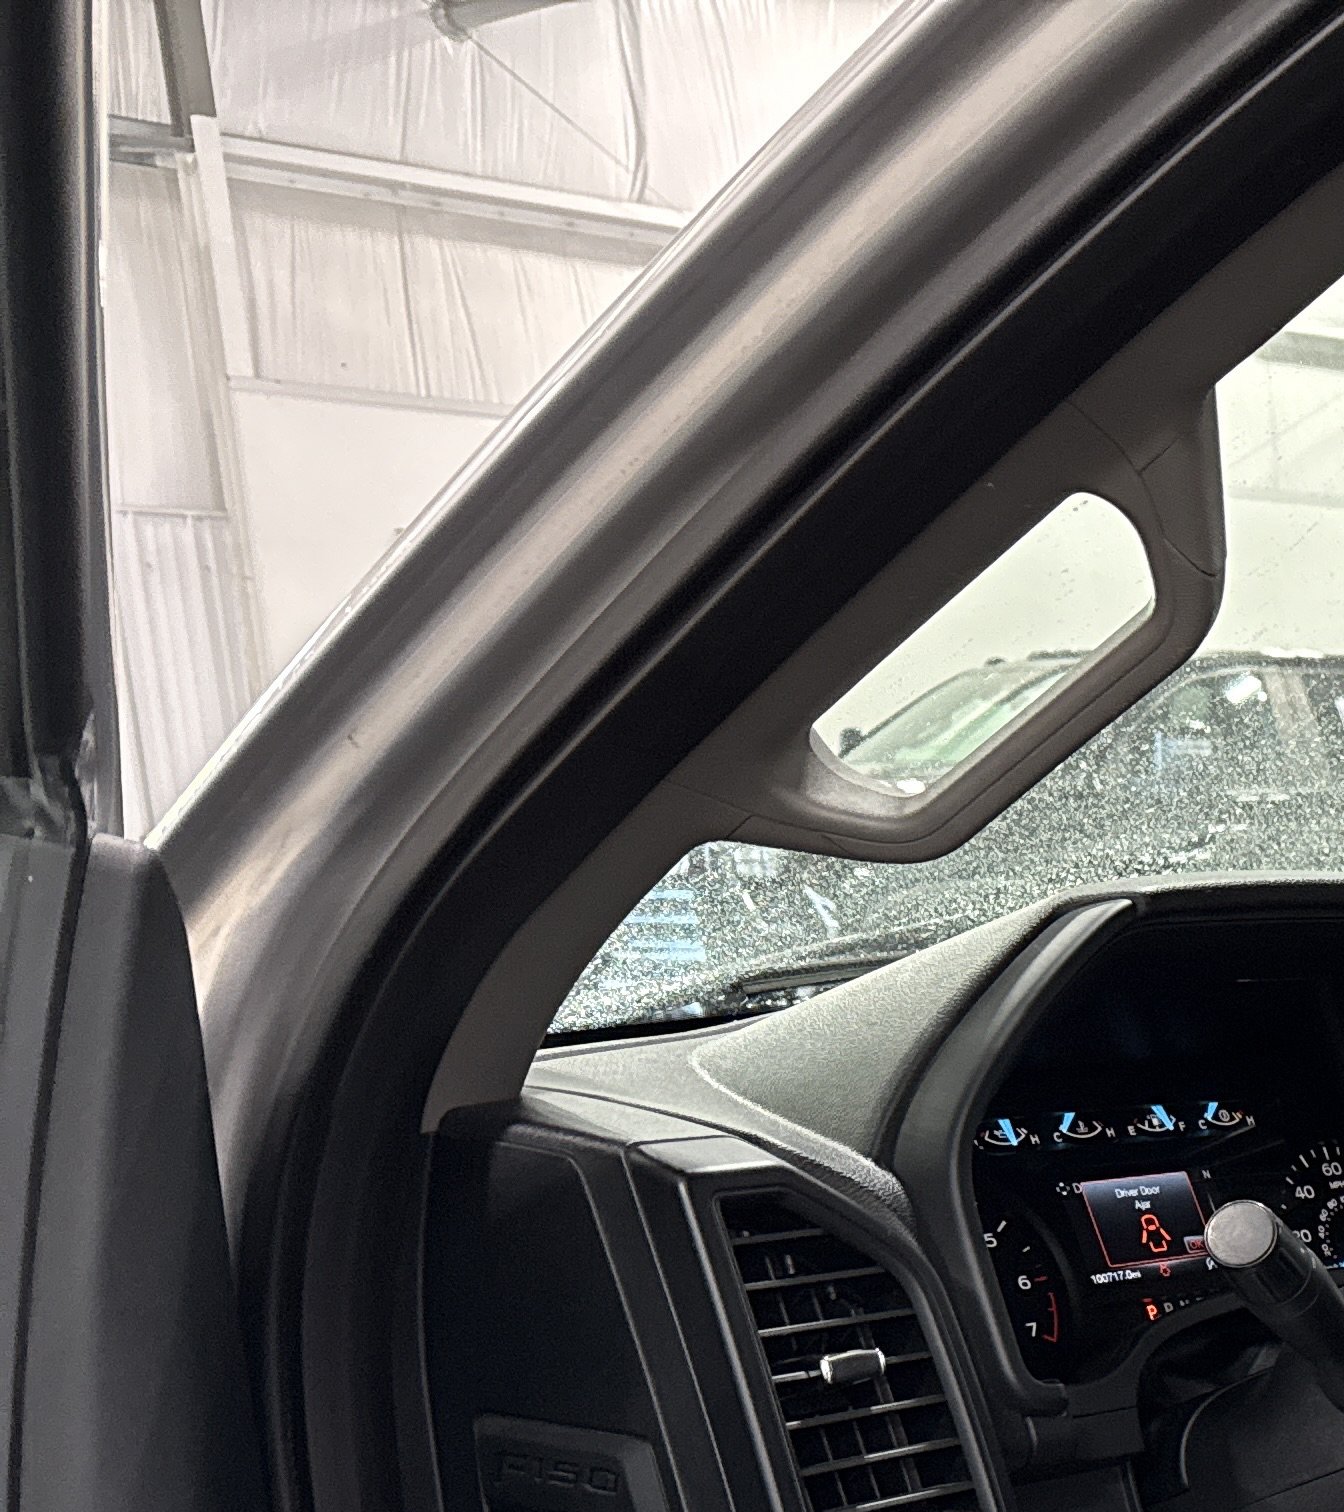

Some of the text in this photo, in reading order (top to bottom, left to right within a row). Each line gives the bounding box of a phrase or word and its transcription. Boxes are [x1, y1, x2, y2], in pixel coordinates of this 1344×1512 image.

[1127, 1121, 1187, 1137] E F
[1321, 1161, 1342, 1176] 60
[1114, 1185, 1161, 1199] Driver Door
[1295, 1185, 1315, 1199] 40
[1134, 1199, 1151, 1211] Ajar
[983, 1232, 998, 1248] 5
[1189, 1238, 1205, 1250] OK
[1017, 1274, 1032, 1290] 6
[1146, 1304, 1158, 1321] P
[1024, 1321, 1037, 1337] 7
